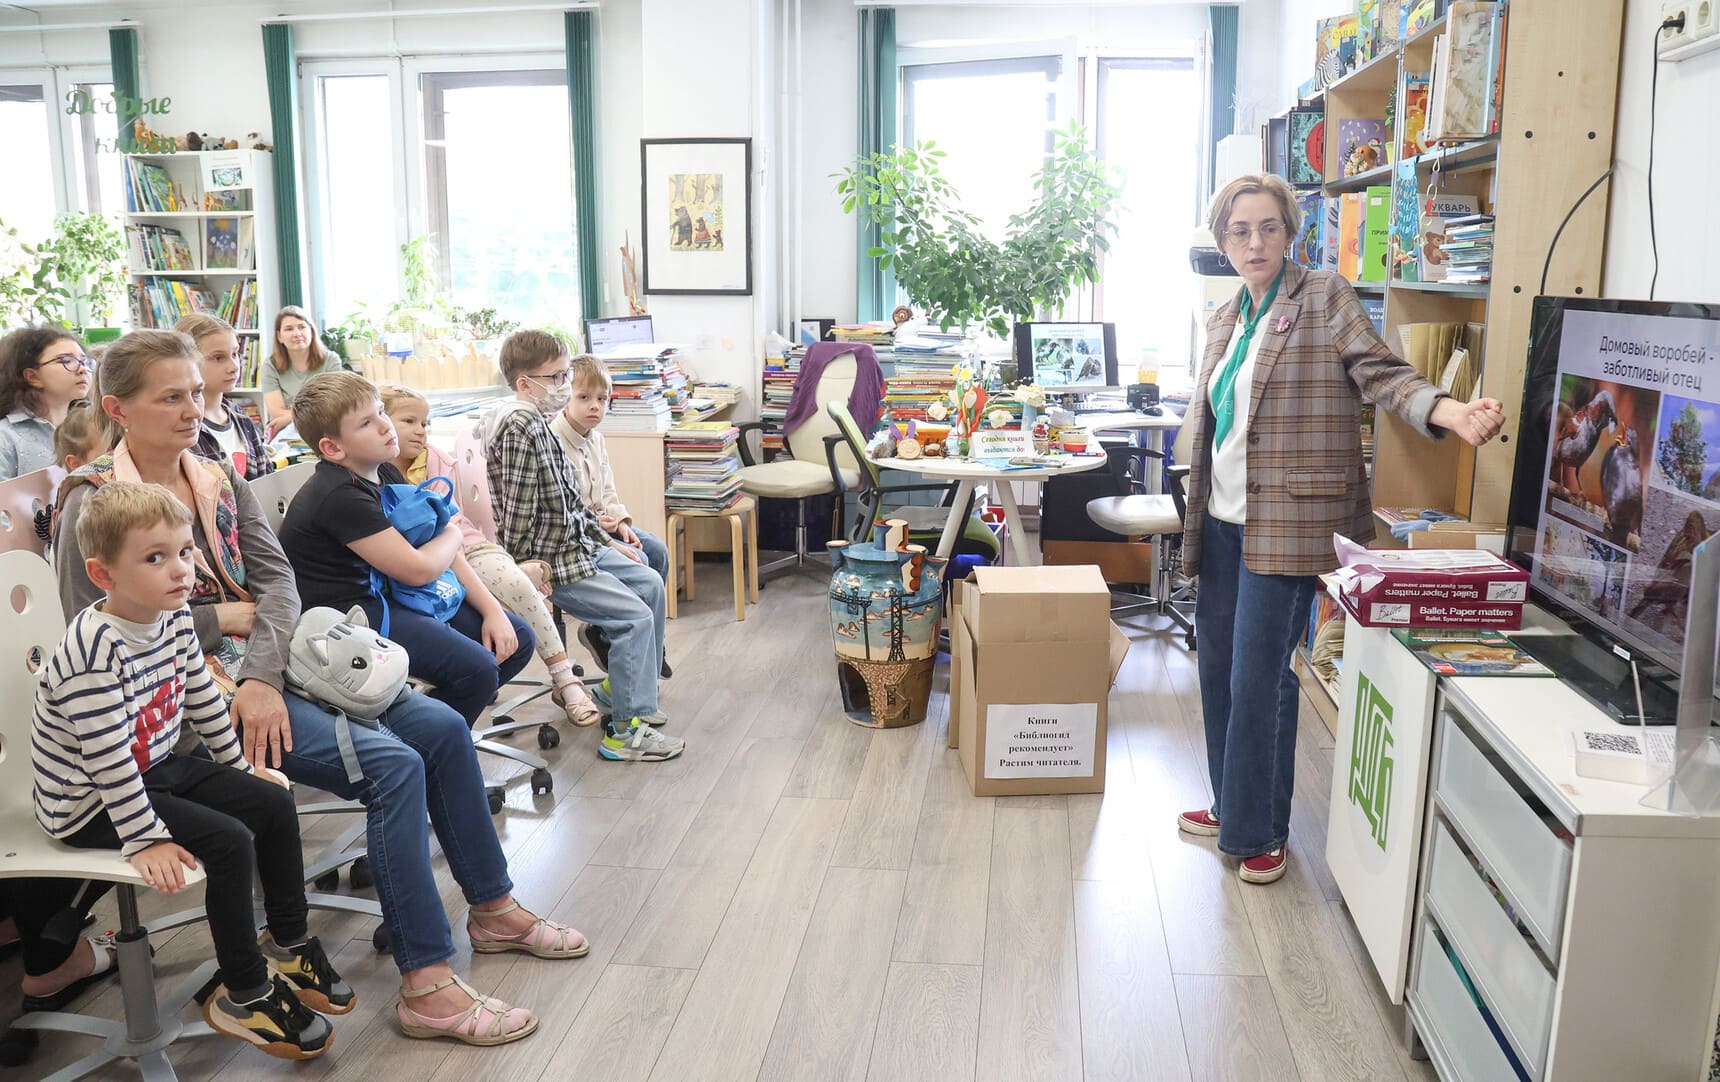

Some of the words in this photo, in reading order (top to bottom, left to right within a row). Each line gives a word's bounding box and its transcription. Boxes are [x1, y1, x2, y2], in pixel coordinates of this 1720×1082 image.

[1424, 203, 1472, 213] УКВАРЬ
[1600, 336, 1649, 357] Домовый
[1652, 345, 1705, 363] воробей
[1603, 360, 1669, 383] заботливый
[1672, 373, 1702, 391] отец
[1384, 588, 1420, 597] matters
[1421, 589, 1449, 598] Paper
[1420, 606, 1448, 615] Ballet.
[1449, 607, 1477, 617] Paper
[1478, 608, 1514, 616] matters
[1027, 716, 1058, 725] Книги
[1013, 731, 1070, 740] «Библиогид
[1008, 745, 1074, 754] рекомендует»
[999, 759, 1034, 767] Растим
[1036, 758, 1082, 766] читателя.
